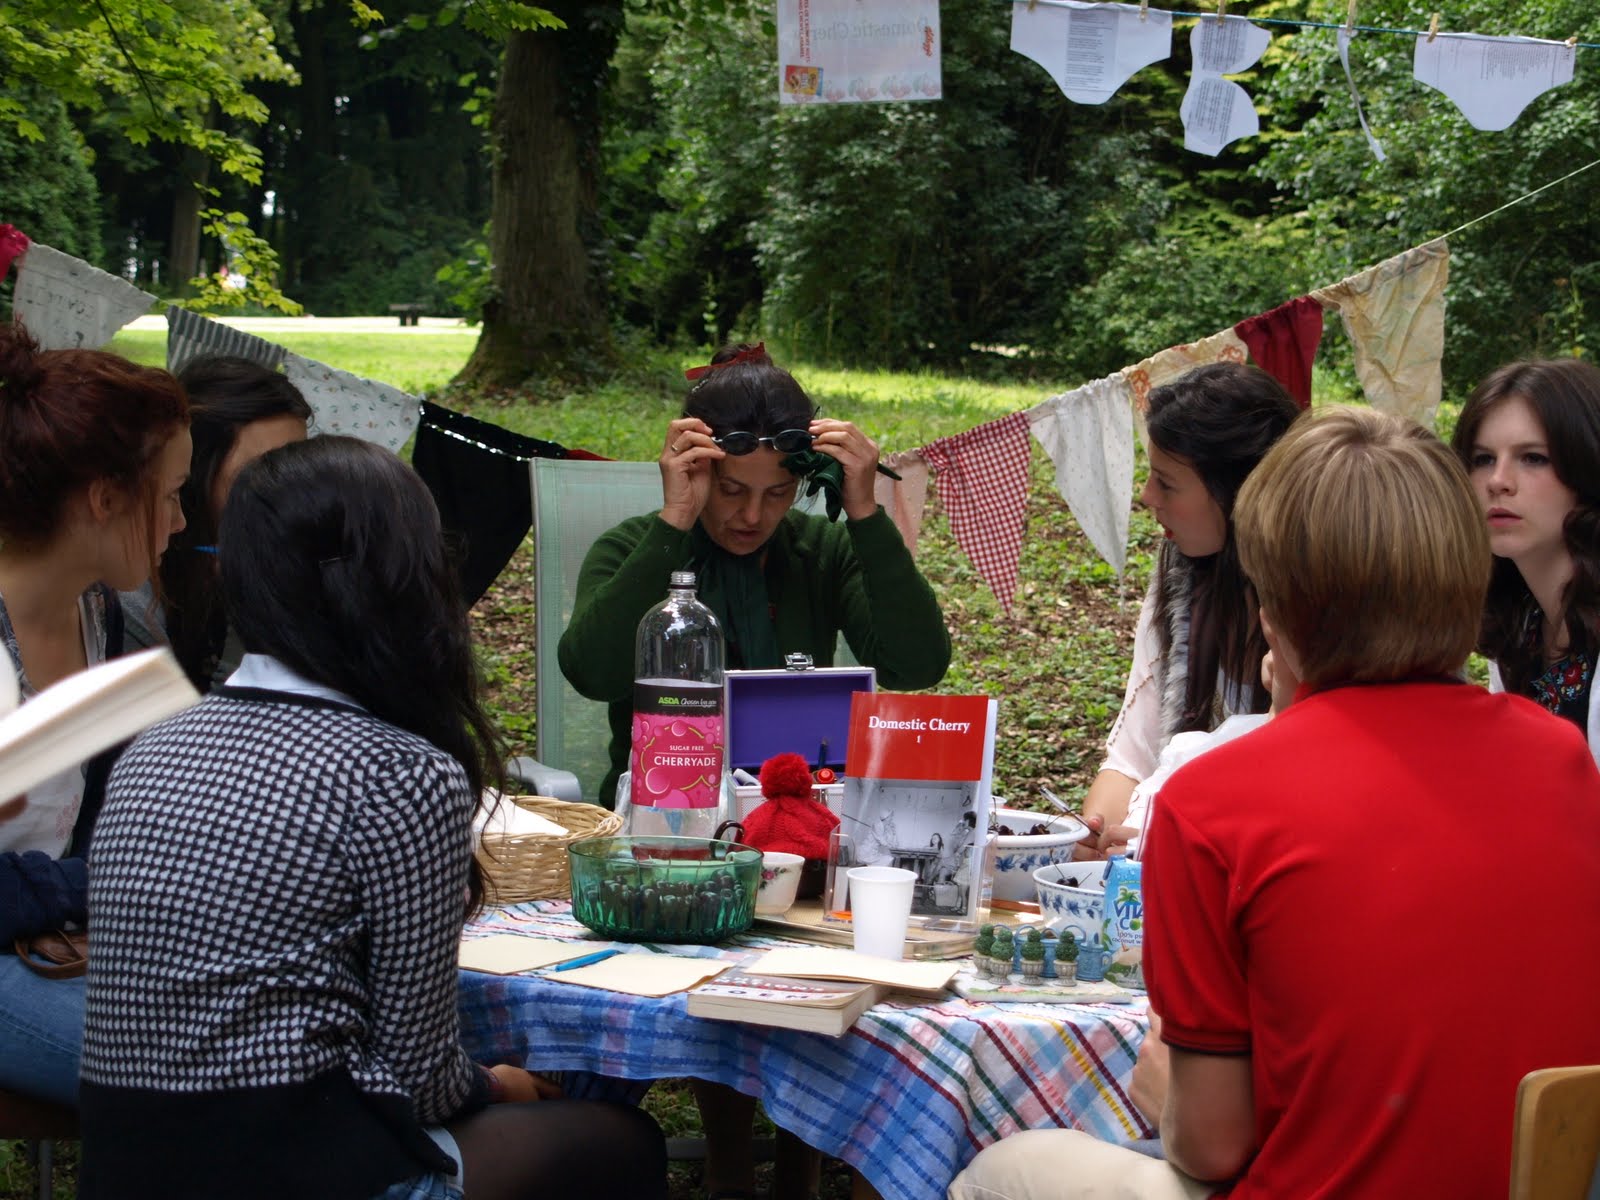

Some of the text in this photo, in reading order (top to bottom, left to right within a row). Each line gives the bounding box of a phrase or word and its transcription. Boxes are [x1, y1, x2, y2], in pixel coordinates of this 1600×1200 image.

[658, 697, 680, 705] ASDA
[868, 716, 970, 734] Domestic Cherry
[654, 756, 716, 766] CHERRYADE
